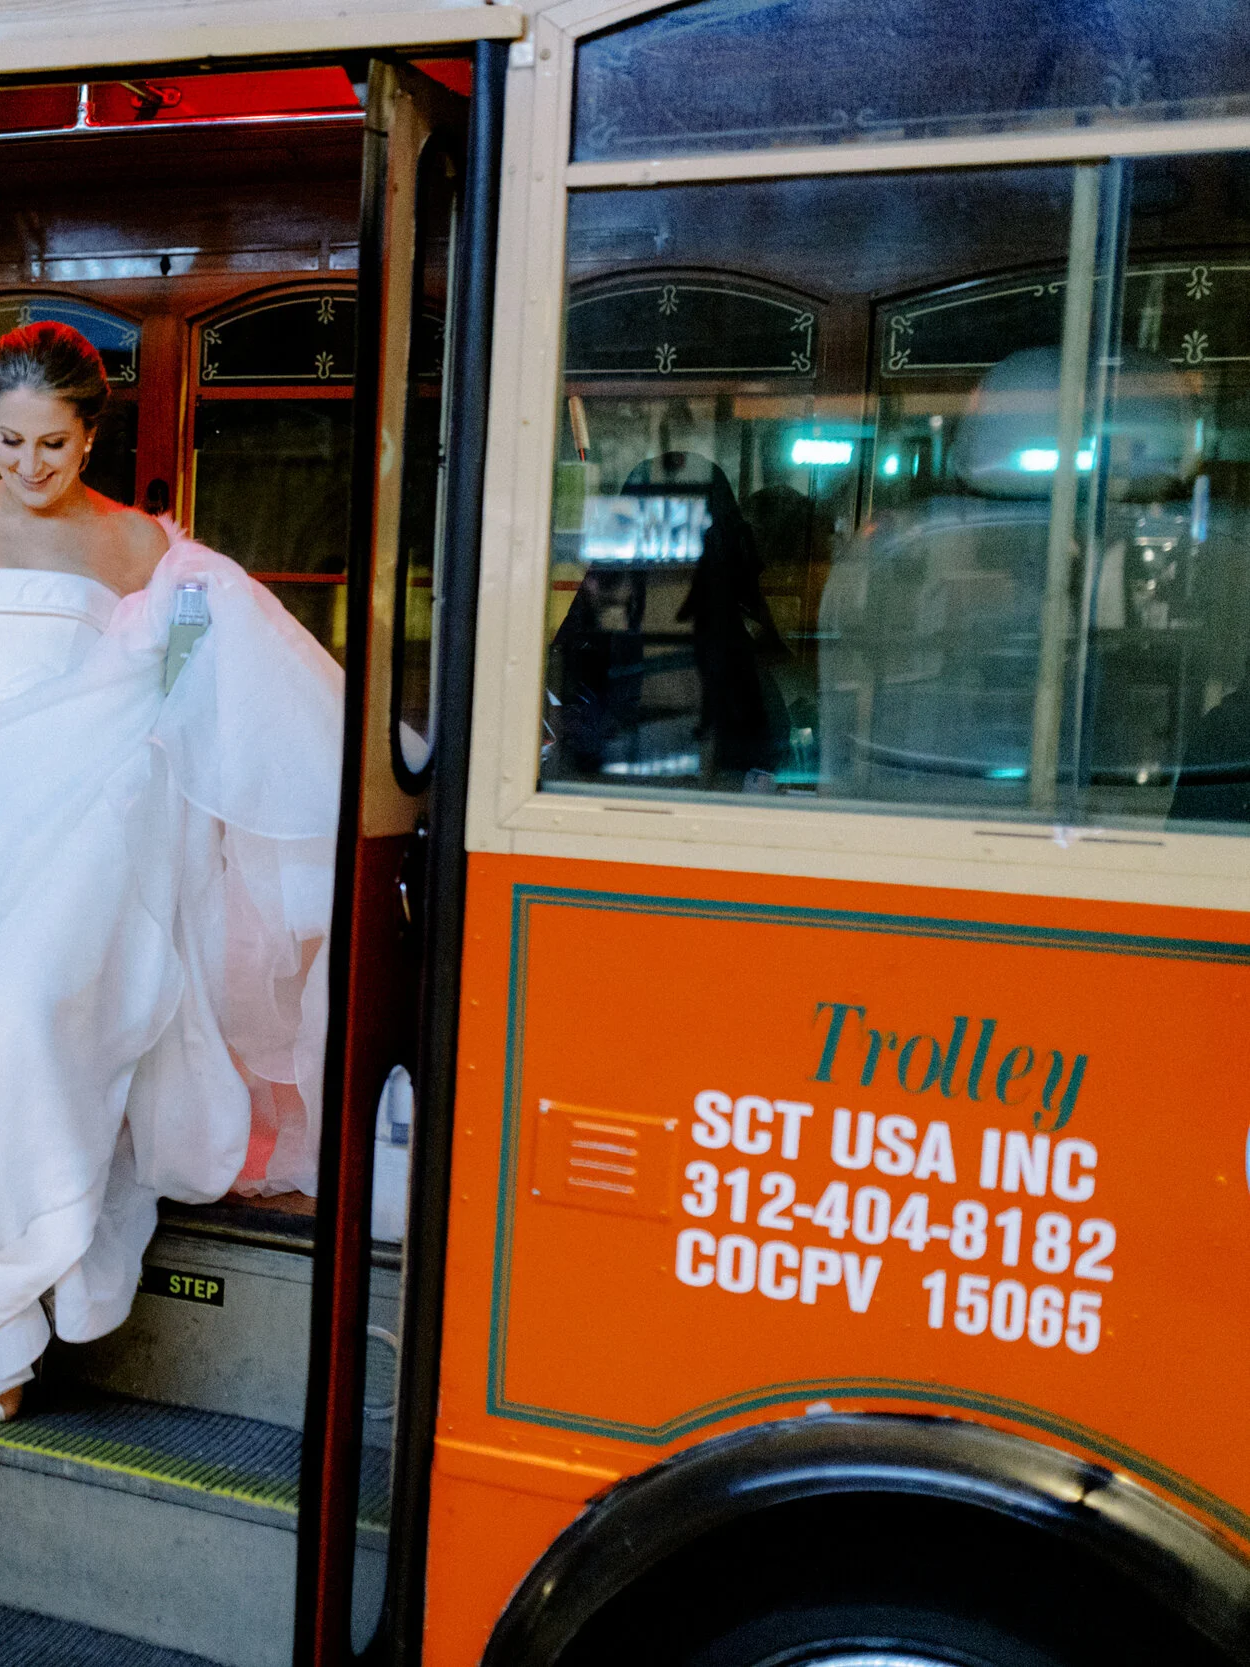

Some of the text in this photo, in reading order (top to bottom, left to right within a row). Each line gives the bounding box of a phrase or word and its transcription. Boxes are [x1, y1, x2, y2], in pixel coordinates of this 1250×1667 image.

[808, 1001, 1089, 1132] Trolley
[691, 1089, 1099, 1203] SCT USA INC
[681, 1160, 1118, 1283] 312-404-8182
[168, 1274, 219, 1300] STEP
[674, 1228, 1104, 1355] COCPV 15065
